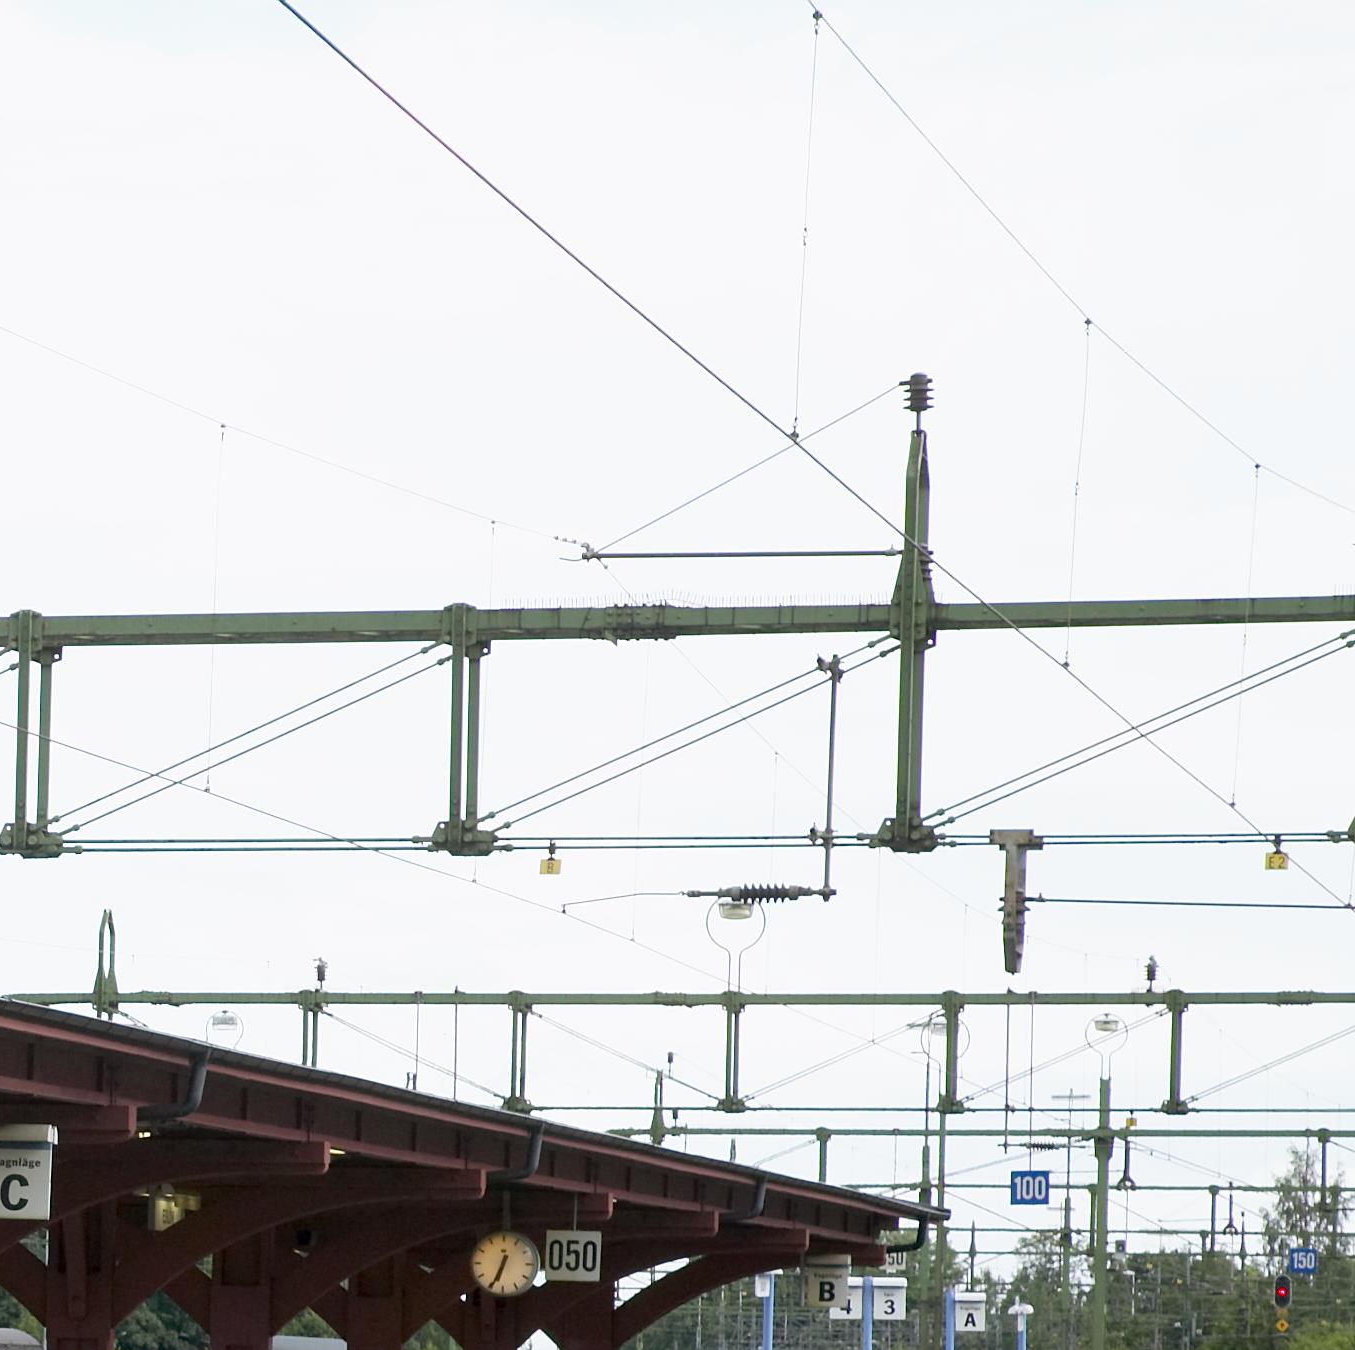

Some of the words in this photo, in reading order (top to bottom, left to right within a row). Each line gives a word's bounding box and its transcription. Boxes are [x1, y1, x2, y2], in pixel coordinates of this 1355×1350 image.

[0, 1173, 29, 1211] C
[1013, 1175, 1047, 1201] 100
[549, 1239, 597, 1272] 050
[1292, 1251, 1316, 1270] 150
[818, 1281, 836, 1302] B
[883, 1299, 896, 1316] 3
[964, 1312, 977, 1328] A
